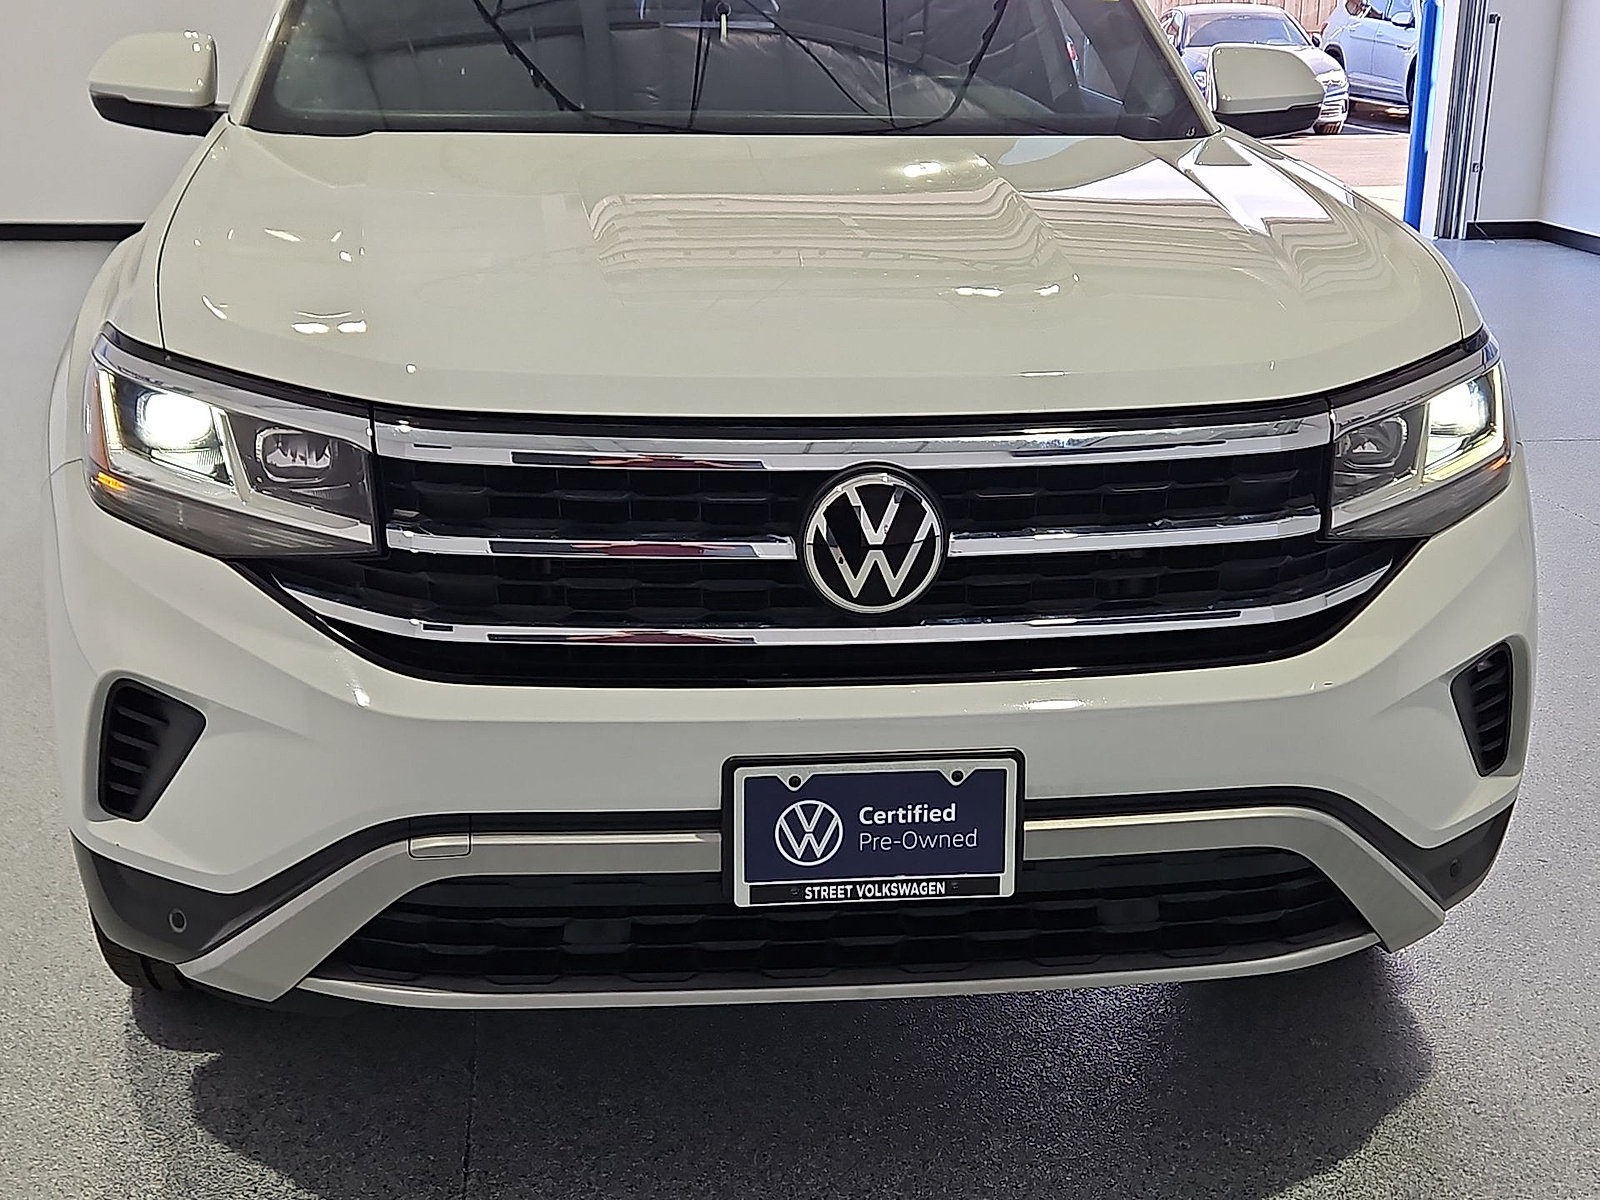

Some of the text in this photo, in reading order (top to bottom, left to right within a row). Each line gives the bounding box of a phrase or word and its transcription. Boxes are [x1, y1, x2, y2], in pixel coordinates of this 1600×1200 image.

[858, 803, 957, 825] Certified
[858, 828, 978, 851] Pre-Owned
[804, 881, 946, 899] STREET VOLKSWAGEN
